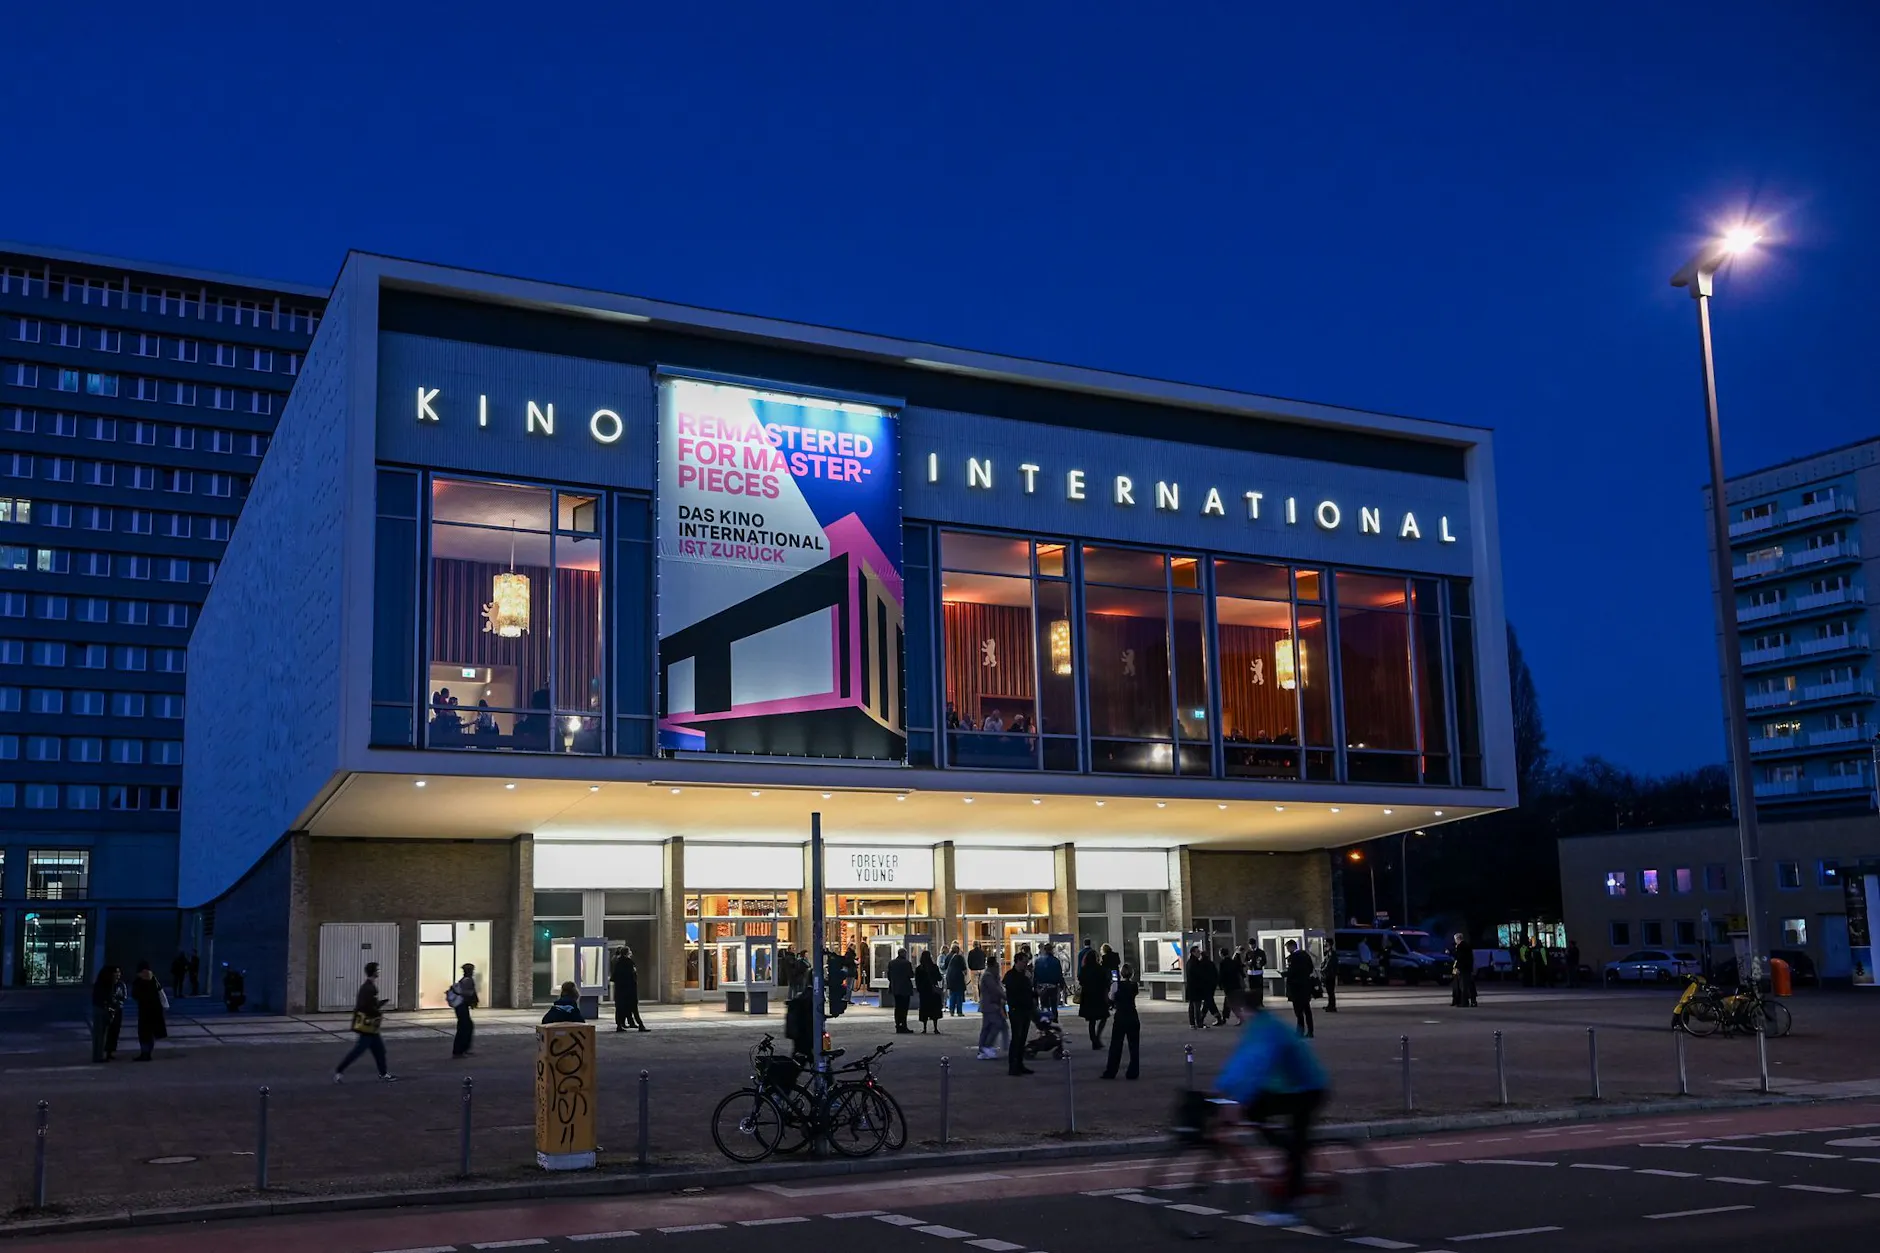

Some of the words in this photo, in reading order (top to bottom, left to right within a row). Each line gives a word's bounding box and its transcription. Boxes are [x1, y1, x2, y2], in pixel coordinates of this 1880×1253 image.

[678, 412, 873, 458] REMASTERED
[417, 386, 623, 443] KINO
[927, 452, 1457, 543] INTERNATIONAL
[678, 438, 737, 468] FOR
[743, 447, 872, 483] MASTER-
[678, 465, 780, 499] PIECES
[678, 505, 715, 522] DAS
[720, 510, 764, 528] KINO
[678, 523, 824, 550] INTERNATIONAL
[679, 539, 708, 556] IST
[711, 541, 785, 563] ZURÜCK
[851, 854, 899, 868] FOREVER
[856, 868, 894, 882] YOUNG
